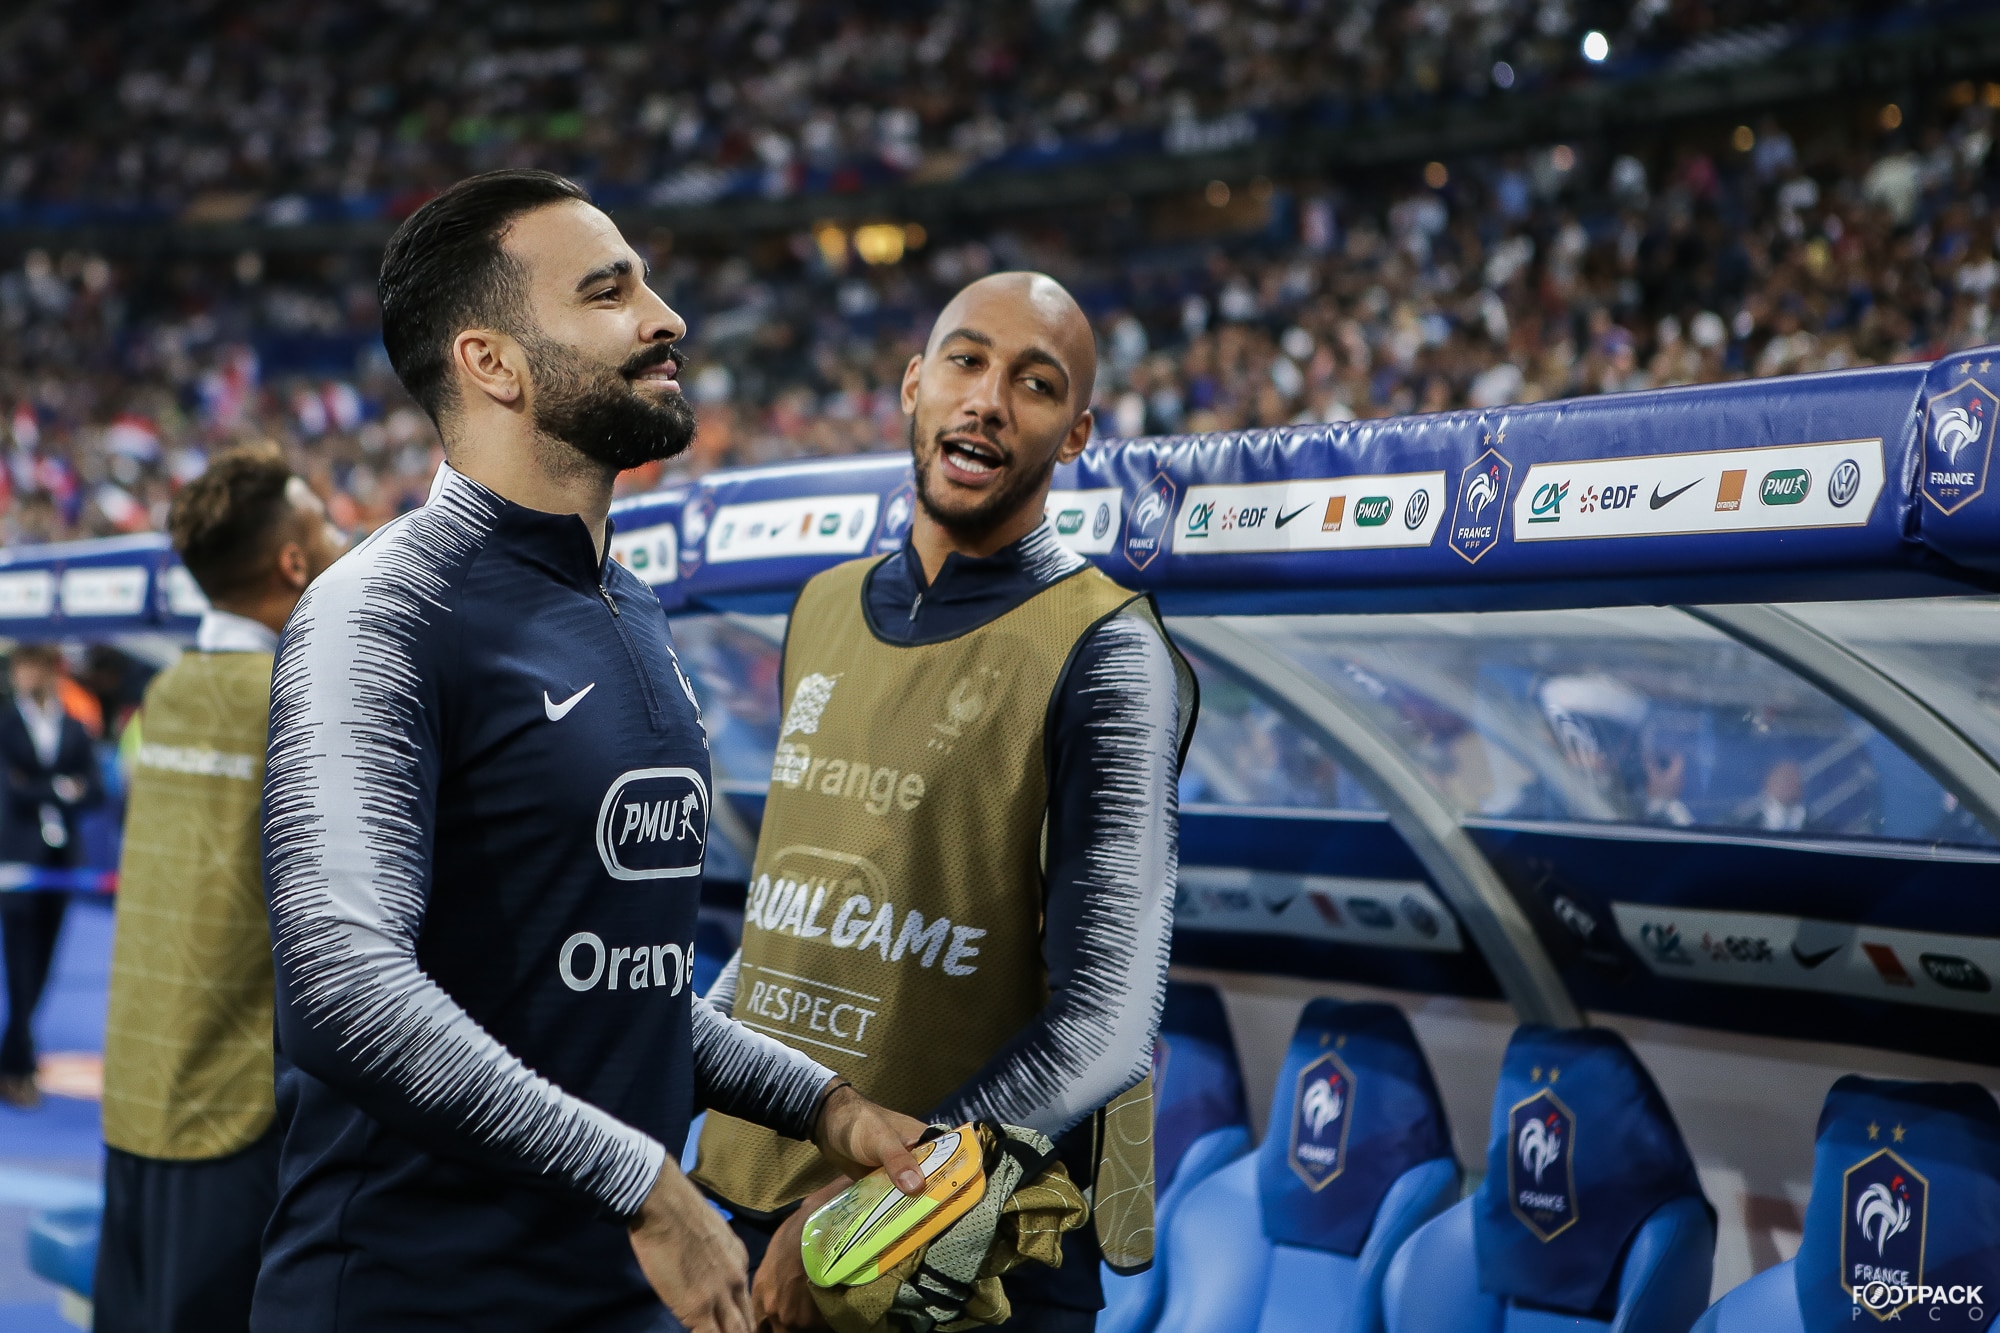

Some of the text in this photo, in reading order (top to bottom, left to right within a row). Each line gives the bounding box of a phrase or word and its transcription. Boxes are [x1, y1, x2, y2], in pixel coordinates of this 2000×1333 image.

[1930, 472, 1976, 486] FRANCE
[1716, 501, 1740, 511] orange
[1763, 477, 1794, 497] PMU
[1940, 488, 1960, 497] FFF
[1356, 503, 1381, 520] PMU
[1457, 525, 1492, 540] FRANCE
[1129, 538, 1155, 550] FRANCE
[1465, 541, 1481, 549] FFF
[619, 800, 678, 846] PMU
[746, 873, 827, 938] QUAL
[831, 894, 987, 977] GAME
[747, 981, 876, 1042] RESPECT
[1854, 1263, 1910, 1287] FRANCE
